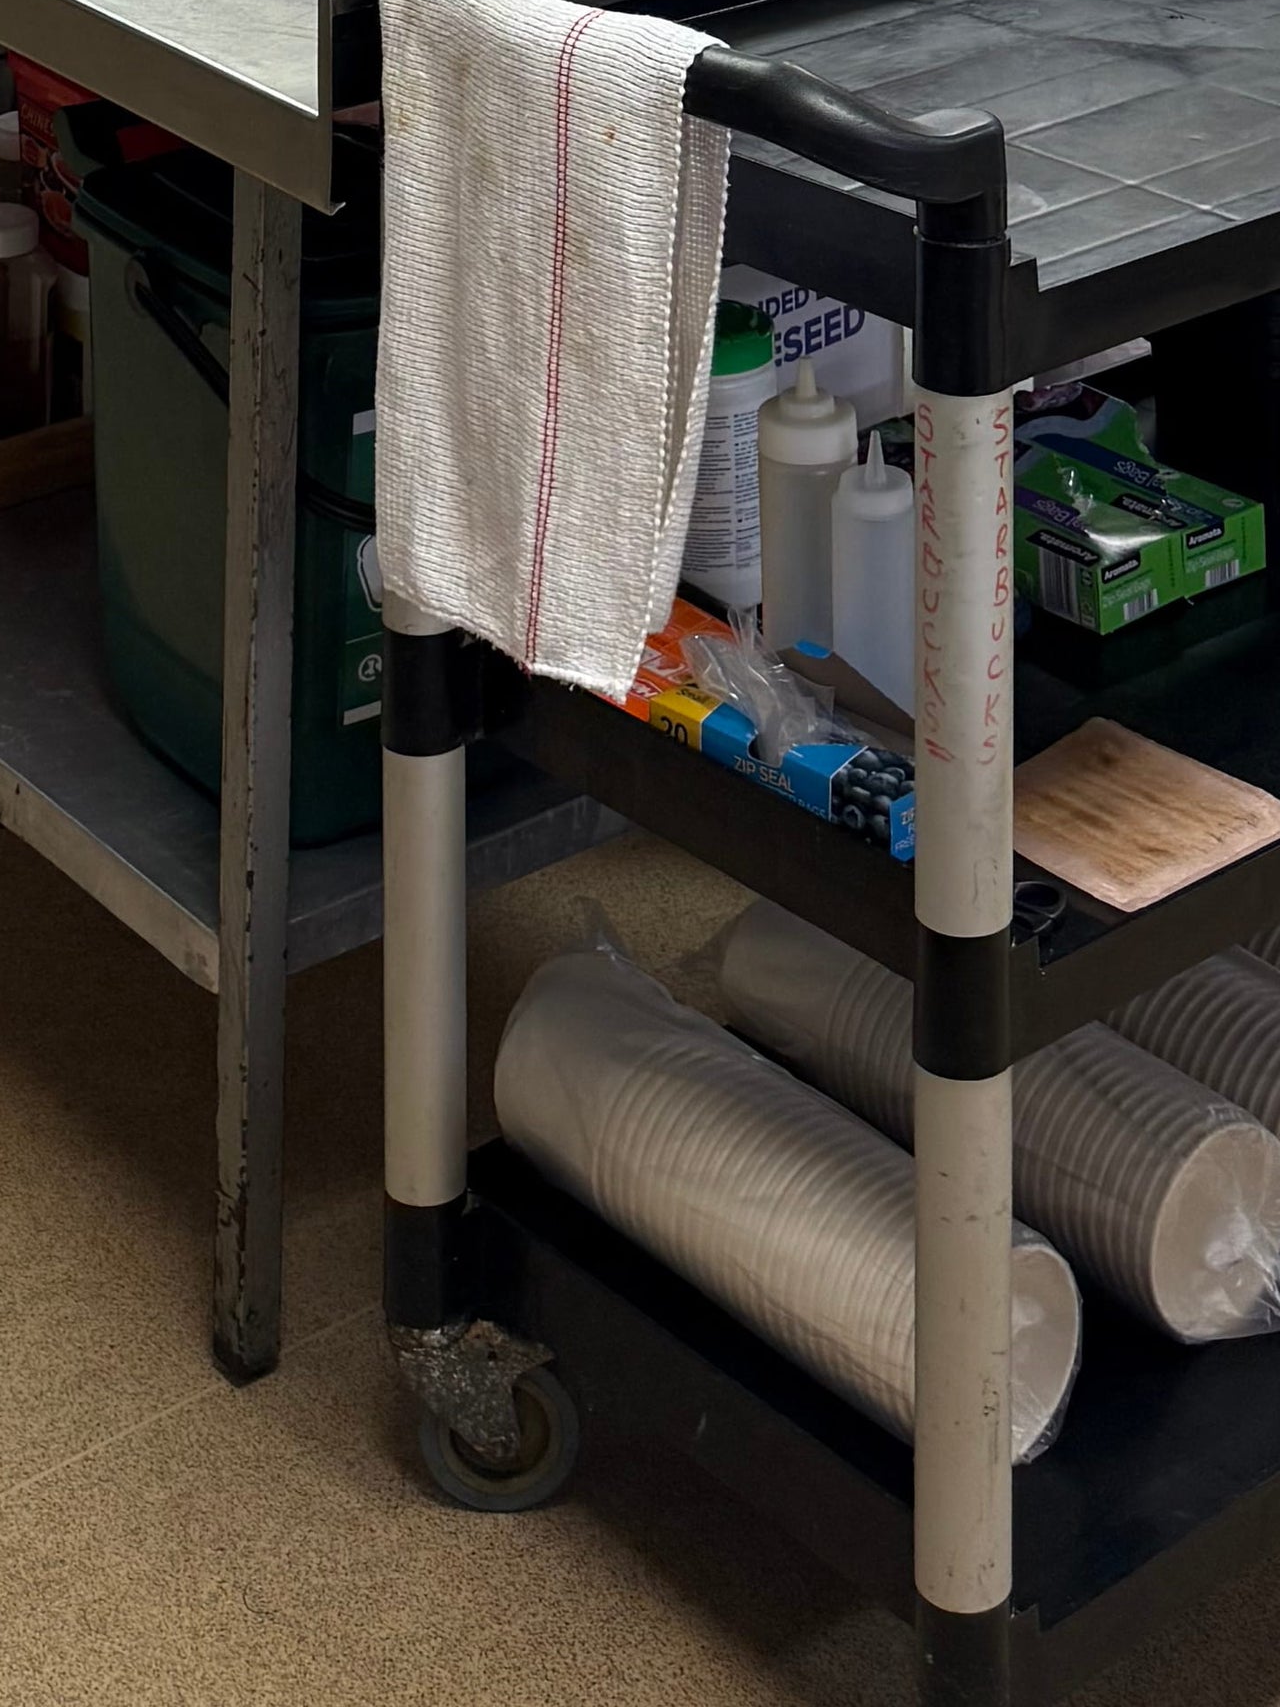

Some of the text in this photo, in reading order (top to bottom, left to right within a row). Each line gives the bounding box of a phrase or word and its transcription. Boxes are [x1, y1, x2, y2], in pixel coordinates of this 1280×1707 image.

[917, 403, 947, 734] STARBUCKS
[977, 406, 1010, 765] STARBUCKS
[733, 755, 756, 776] ZIP
[759, 767, 796, 794] SEAL
